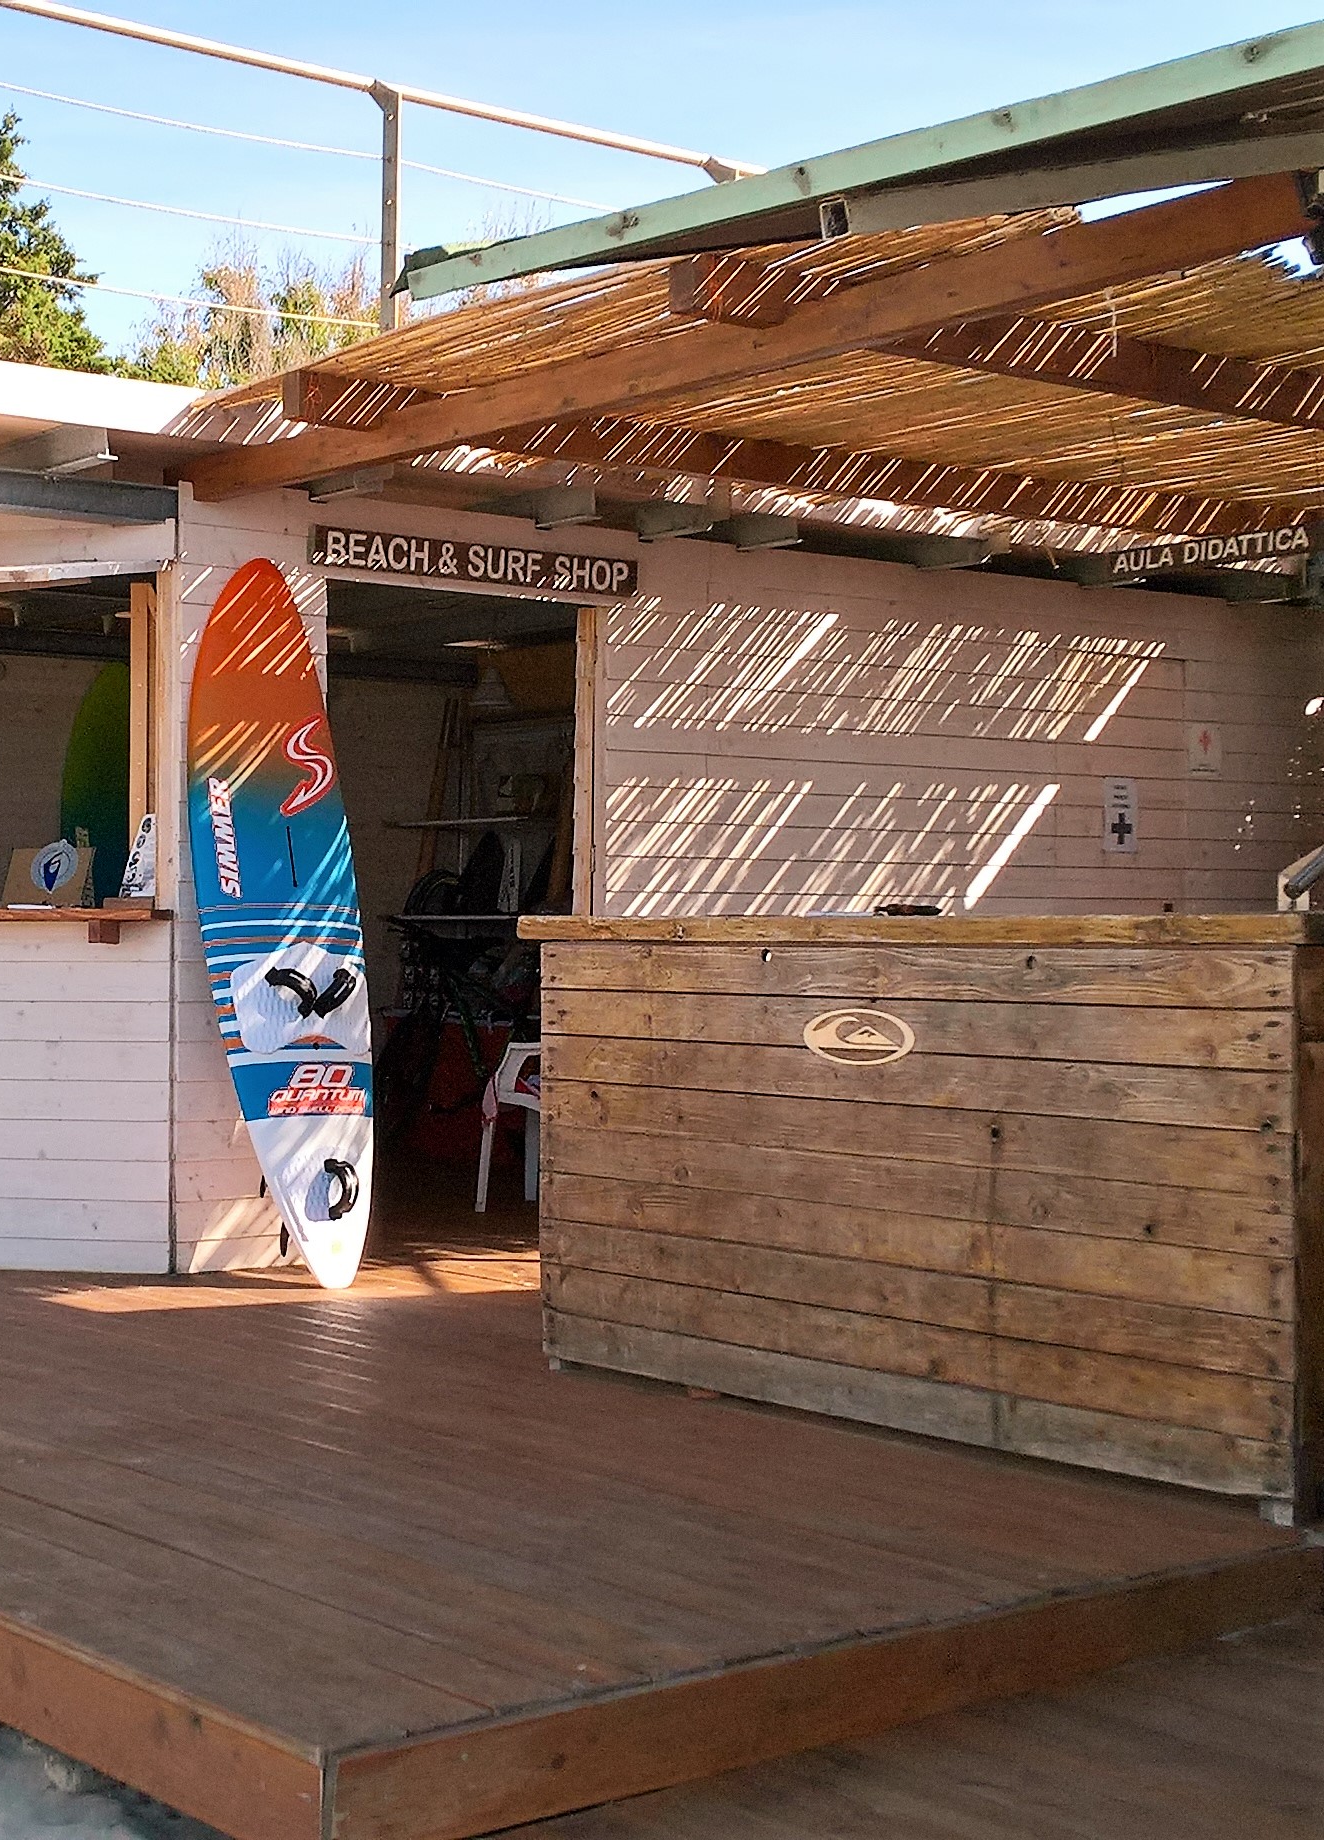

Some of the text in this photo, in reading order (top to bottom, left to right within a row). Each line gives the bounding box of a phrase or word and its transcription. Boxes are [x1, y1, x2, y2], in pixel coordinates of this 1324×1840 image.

[326, 530, 630, 593] BEACH & SURF SHOP
[1113, 526, 1310, 574] AULA DIDATTICA
[208, 776, 242, 898] SIMMER
[269, 1088, 365, 1102] QUANTUM
[288, 1064, 354, 1089] 80
